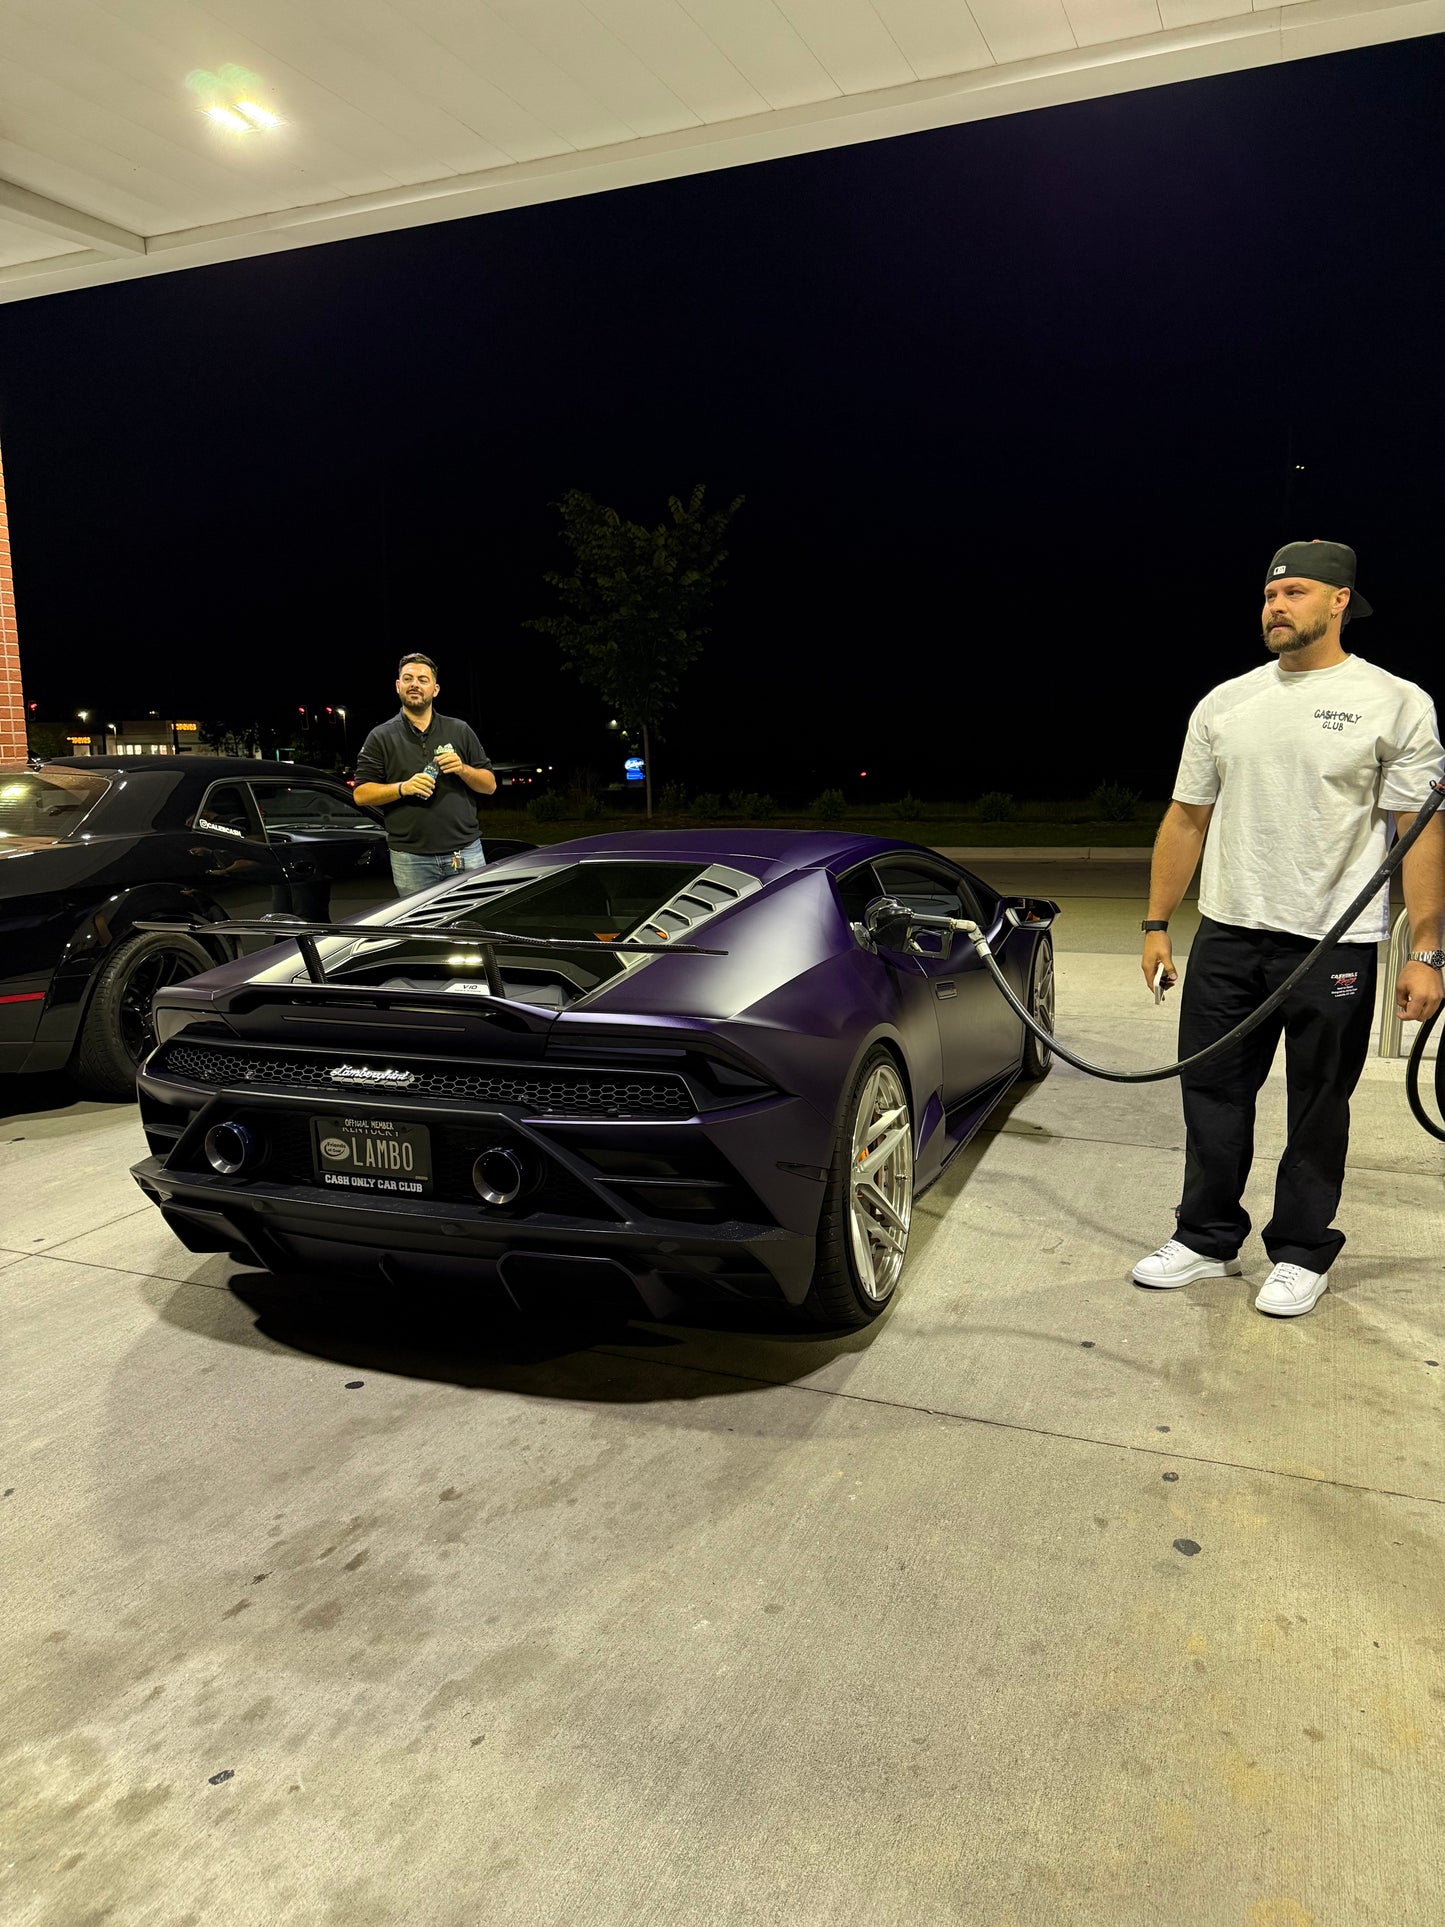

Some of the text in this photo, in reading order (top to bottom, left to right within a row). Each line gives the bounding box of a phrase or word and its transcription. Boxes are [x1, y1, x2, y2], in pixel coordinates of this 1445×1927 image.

[1338, 712, 1362, 724] ONLY
[1322, 721, 1344, 731] CLUB
[329, 1064, 411, 1082] Lamborghini
[345, 1118, 395, 1130] OFFICIAL MEMBER
[351, 1137, 414, 1171] LAMBO
[325, 1174, 423, 1192] CASH ONLY CAR CLUB
